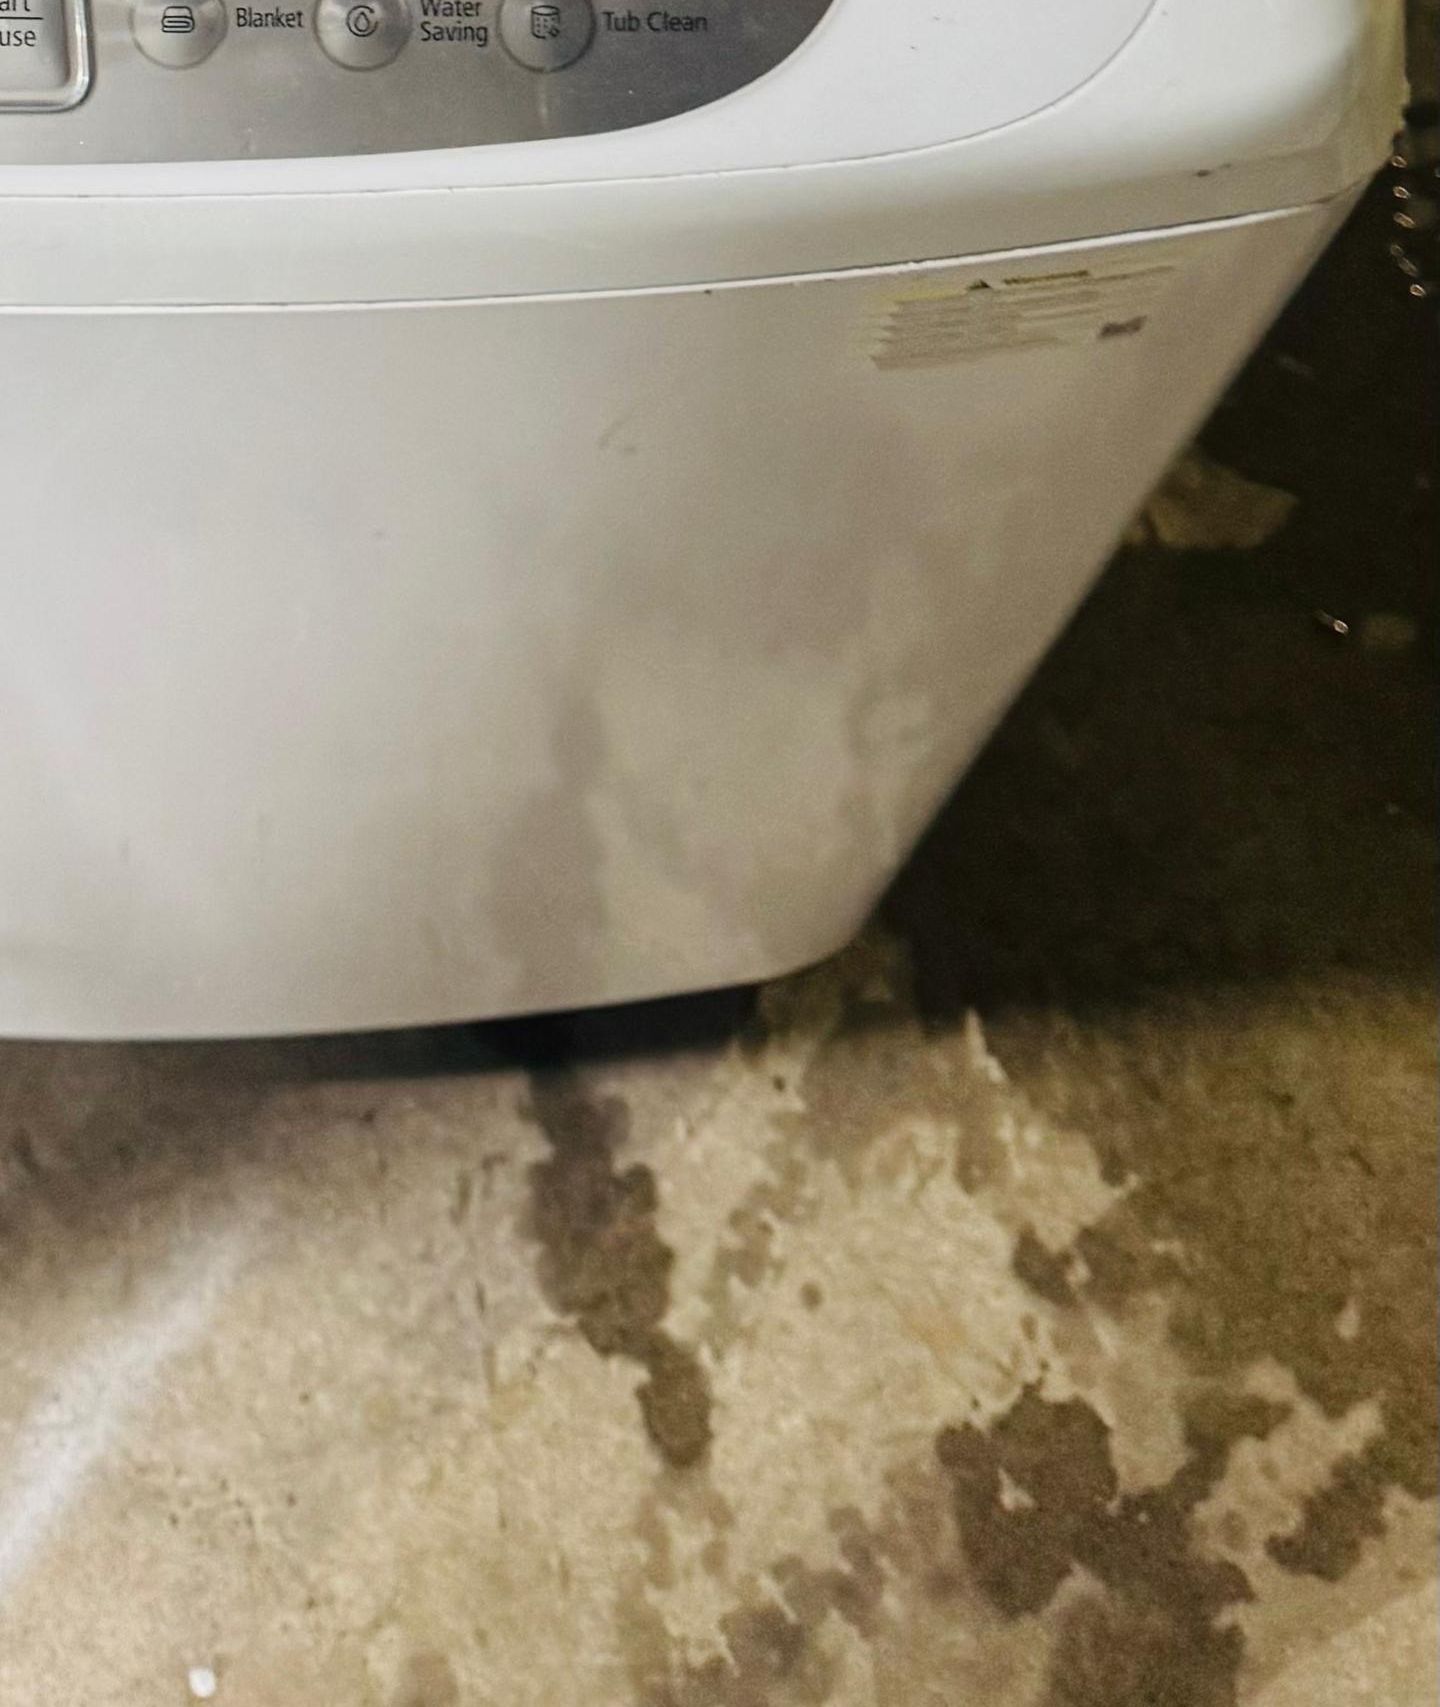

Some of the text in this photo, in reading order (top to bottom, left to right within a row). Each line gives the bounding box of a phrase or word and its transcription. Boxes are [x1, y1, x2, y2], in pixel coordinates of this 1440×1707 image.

[236, 8, 304, 30] Blanket
[604, 11, 708, 33] Tub Clean
[420, 21, 489, 47] Saving
